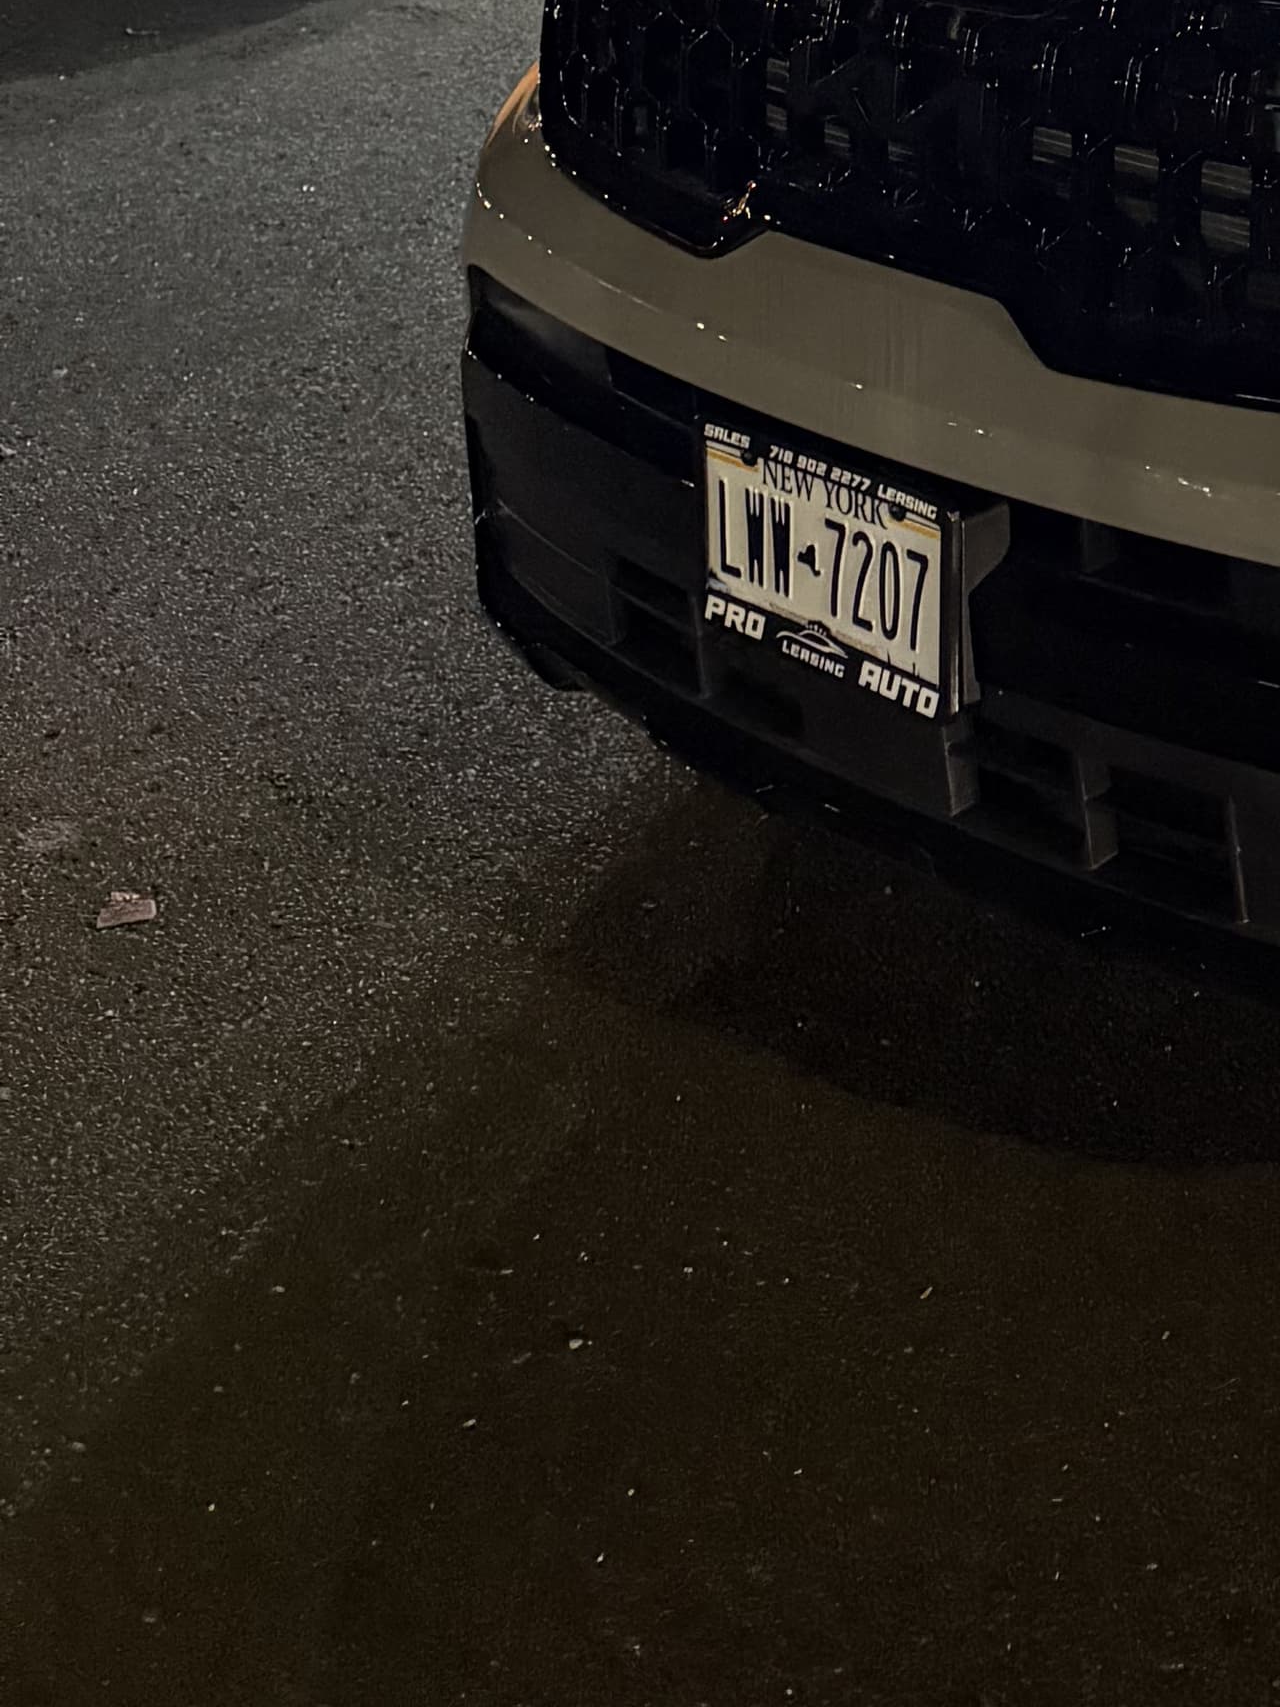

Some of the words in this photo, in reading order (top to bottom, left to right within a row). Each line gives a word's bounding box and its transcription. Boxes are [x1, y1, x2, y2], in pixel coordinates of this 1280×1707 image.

[703, 423, 750, 449] SALES
[768, 445, 794, 465] 718
[796, 454, 827, 477] 902
[829, 465, 871, 493] 2277
[876, 483, 938, 520] LEASING
[760, 457, 817, 502] NEW
[815, 479, 888, 530] YORK
[824, 517, 930, 653] 7207
[704, 593, 766, 642] PRO
[858, 659, 940, 719] AUTO
[781, 639, 845, 679] LEASING
